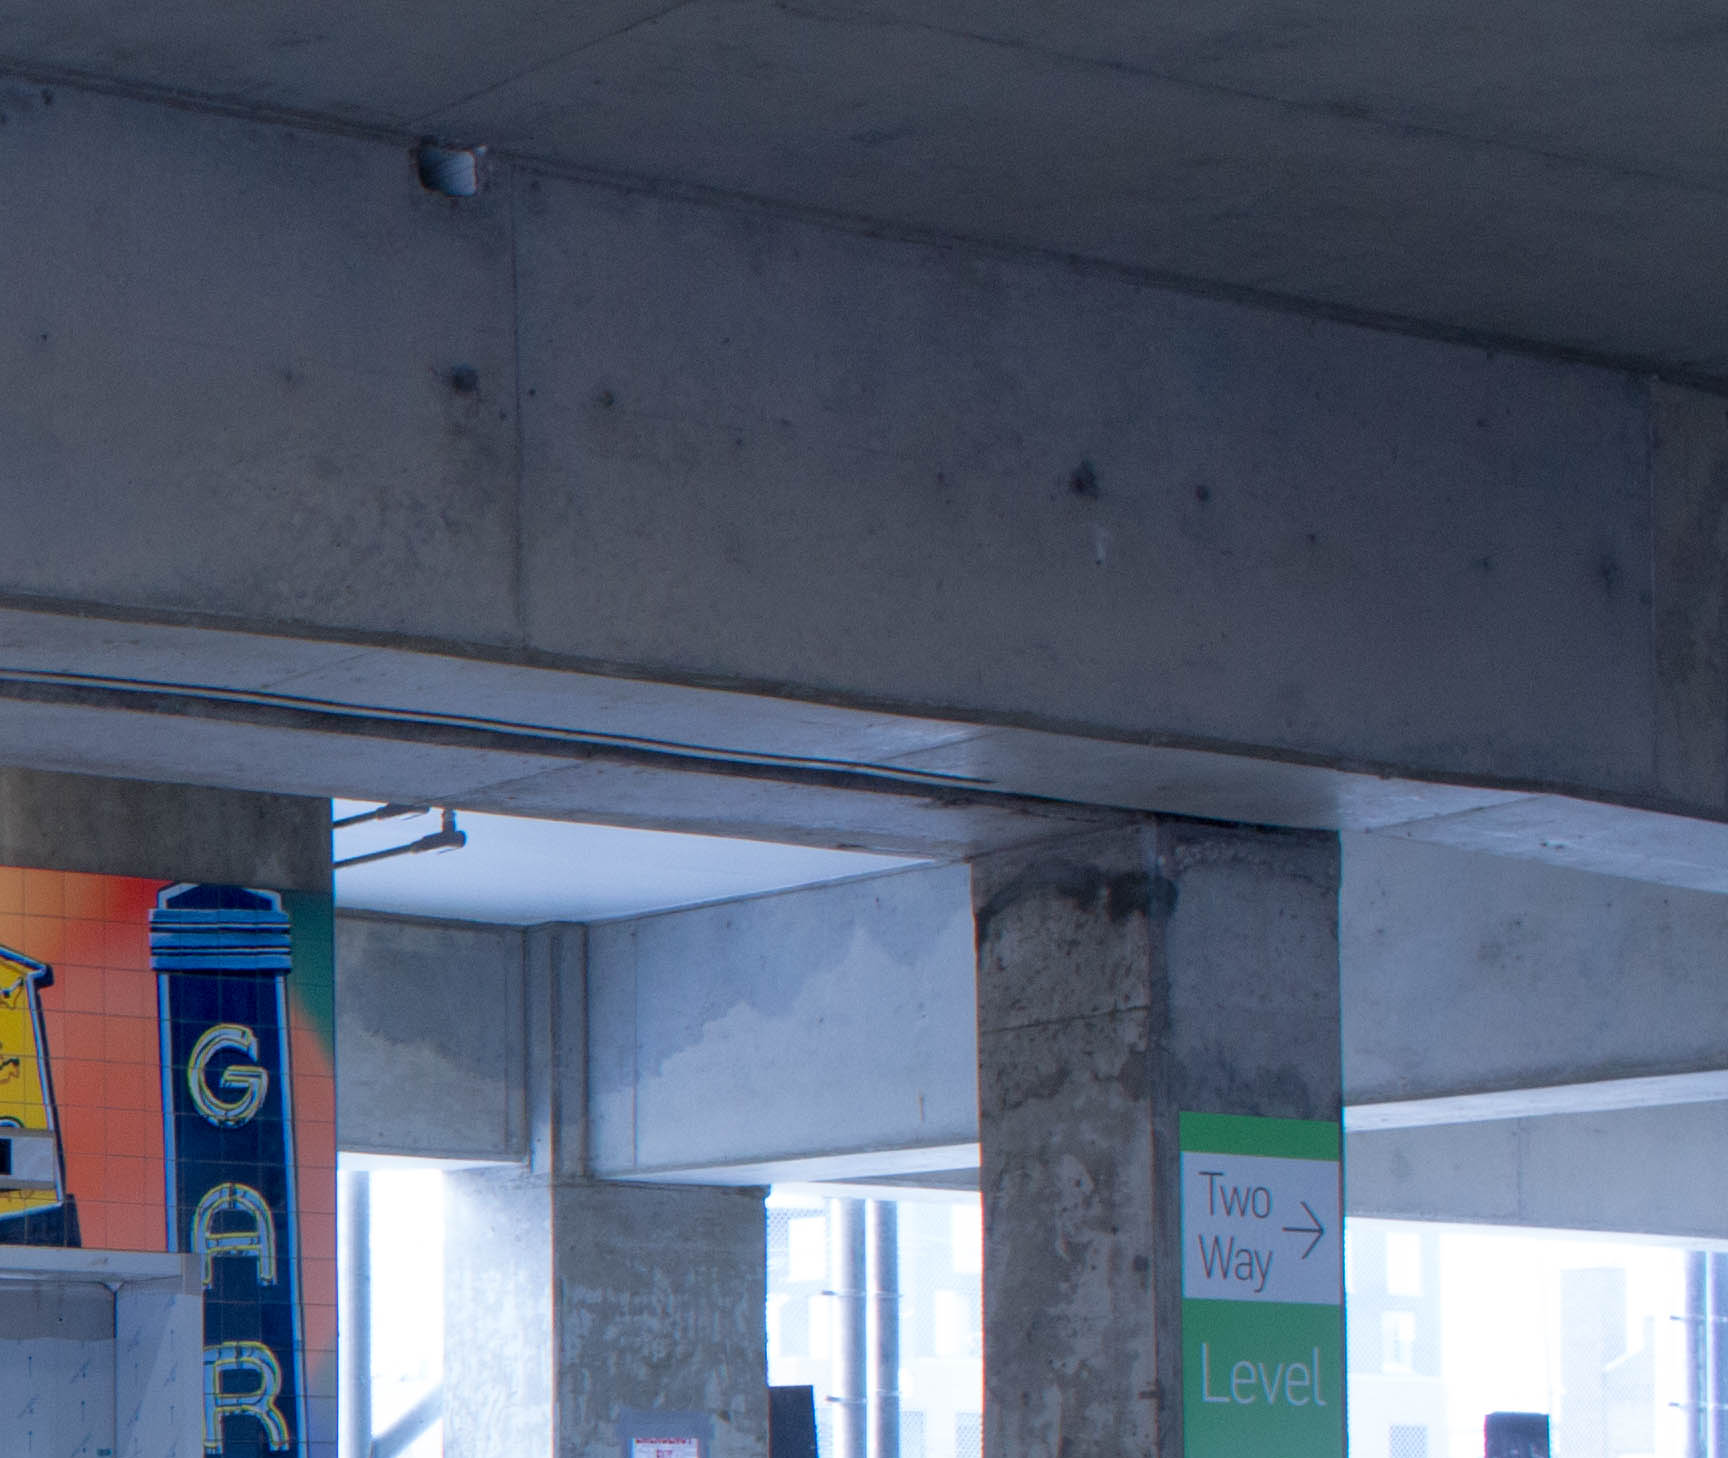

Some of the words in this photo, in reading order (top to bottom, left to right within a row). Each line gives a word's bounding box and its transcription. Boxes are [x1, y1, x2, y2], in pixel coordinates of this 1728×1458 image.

[1198, 1171, 1272, 1219] Two
[1198, 1234, 1273, 1293] Way
[1201, 1343, 1327, 1406] Level
